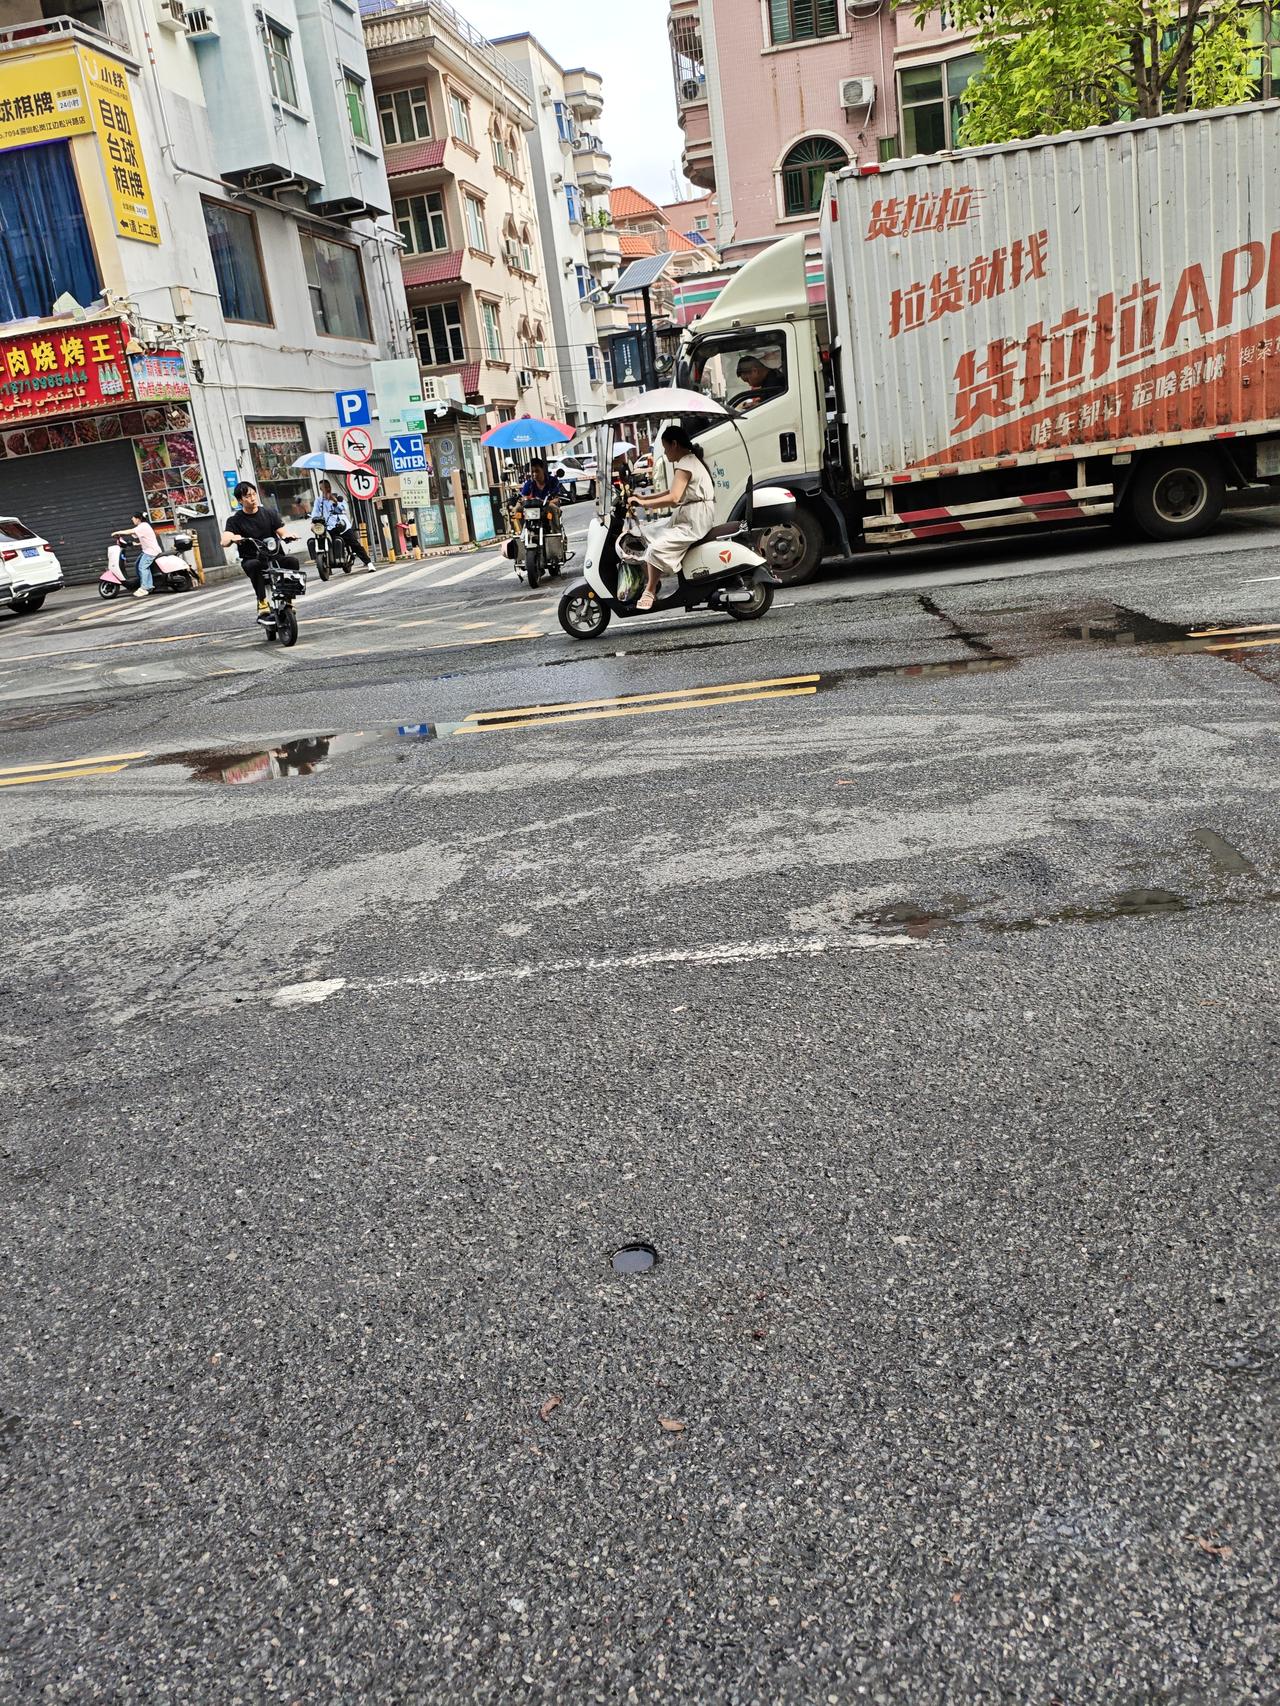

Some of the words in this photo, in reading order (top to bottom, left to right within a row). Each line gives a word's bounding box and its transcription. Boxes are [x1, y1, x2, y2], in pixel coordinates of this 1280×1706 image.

[101, 66, 126, 90] 小铁
[98, 98, 131, 135] 自助
[107, 132, 139, 168] 台球
[113, 165, 145, 199] 棋牌
[864, 185, 974, 241] 货拉拉
[889, 229, 1048, 339] 拉货就找
[950, 230, 1280, 436] 货拉拉AP
[0, 334, 115, 378] 肉烧烤王
[342, 394, 362, 423] P
[393, 439, 423, 454] 入口
[394, 456, 425, 470] ENTER
[354, 474, 371, 490] 15
